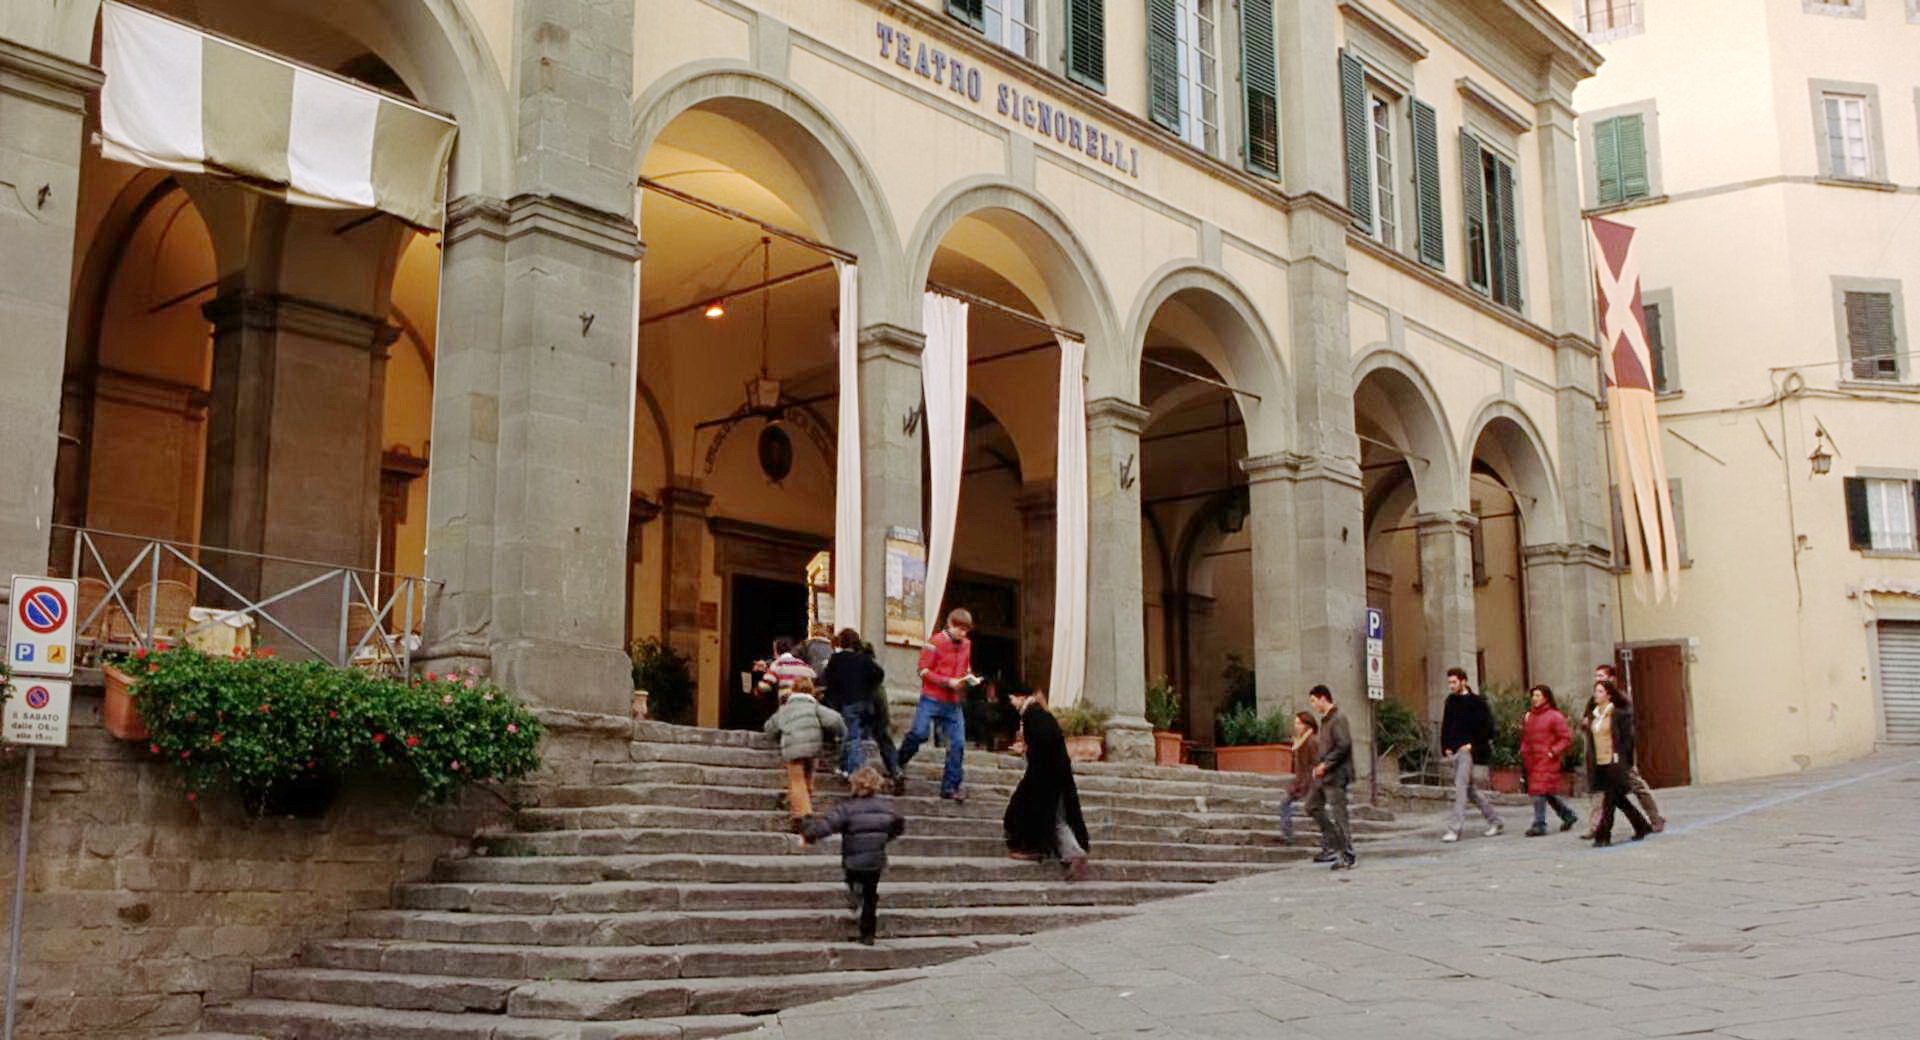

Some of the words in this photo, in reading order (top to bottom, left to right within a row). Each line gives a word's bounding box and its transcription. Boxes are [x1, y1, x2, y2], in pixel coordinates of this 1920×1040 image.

[876, 21, 982, 103] TEATRO
[997, 82, 1139, 178] SIGNORELLI
[1369, 611, 1380, 637] P
[18, 645, 31, 660] P
[23, 712, 60, 722] SABATO
